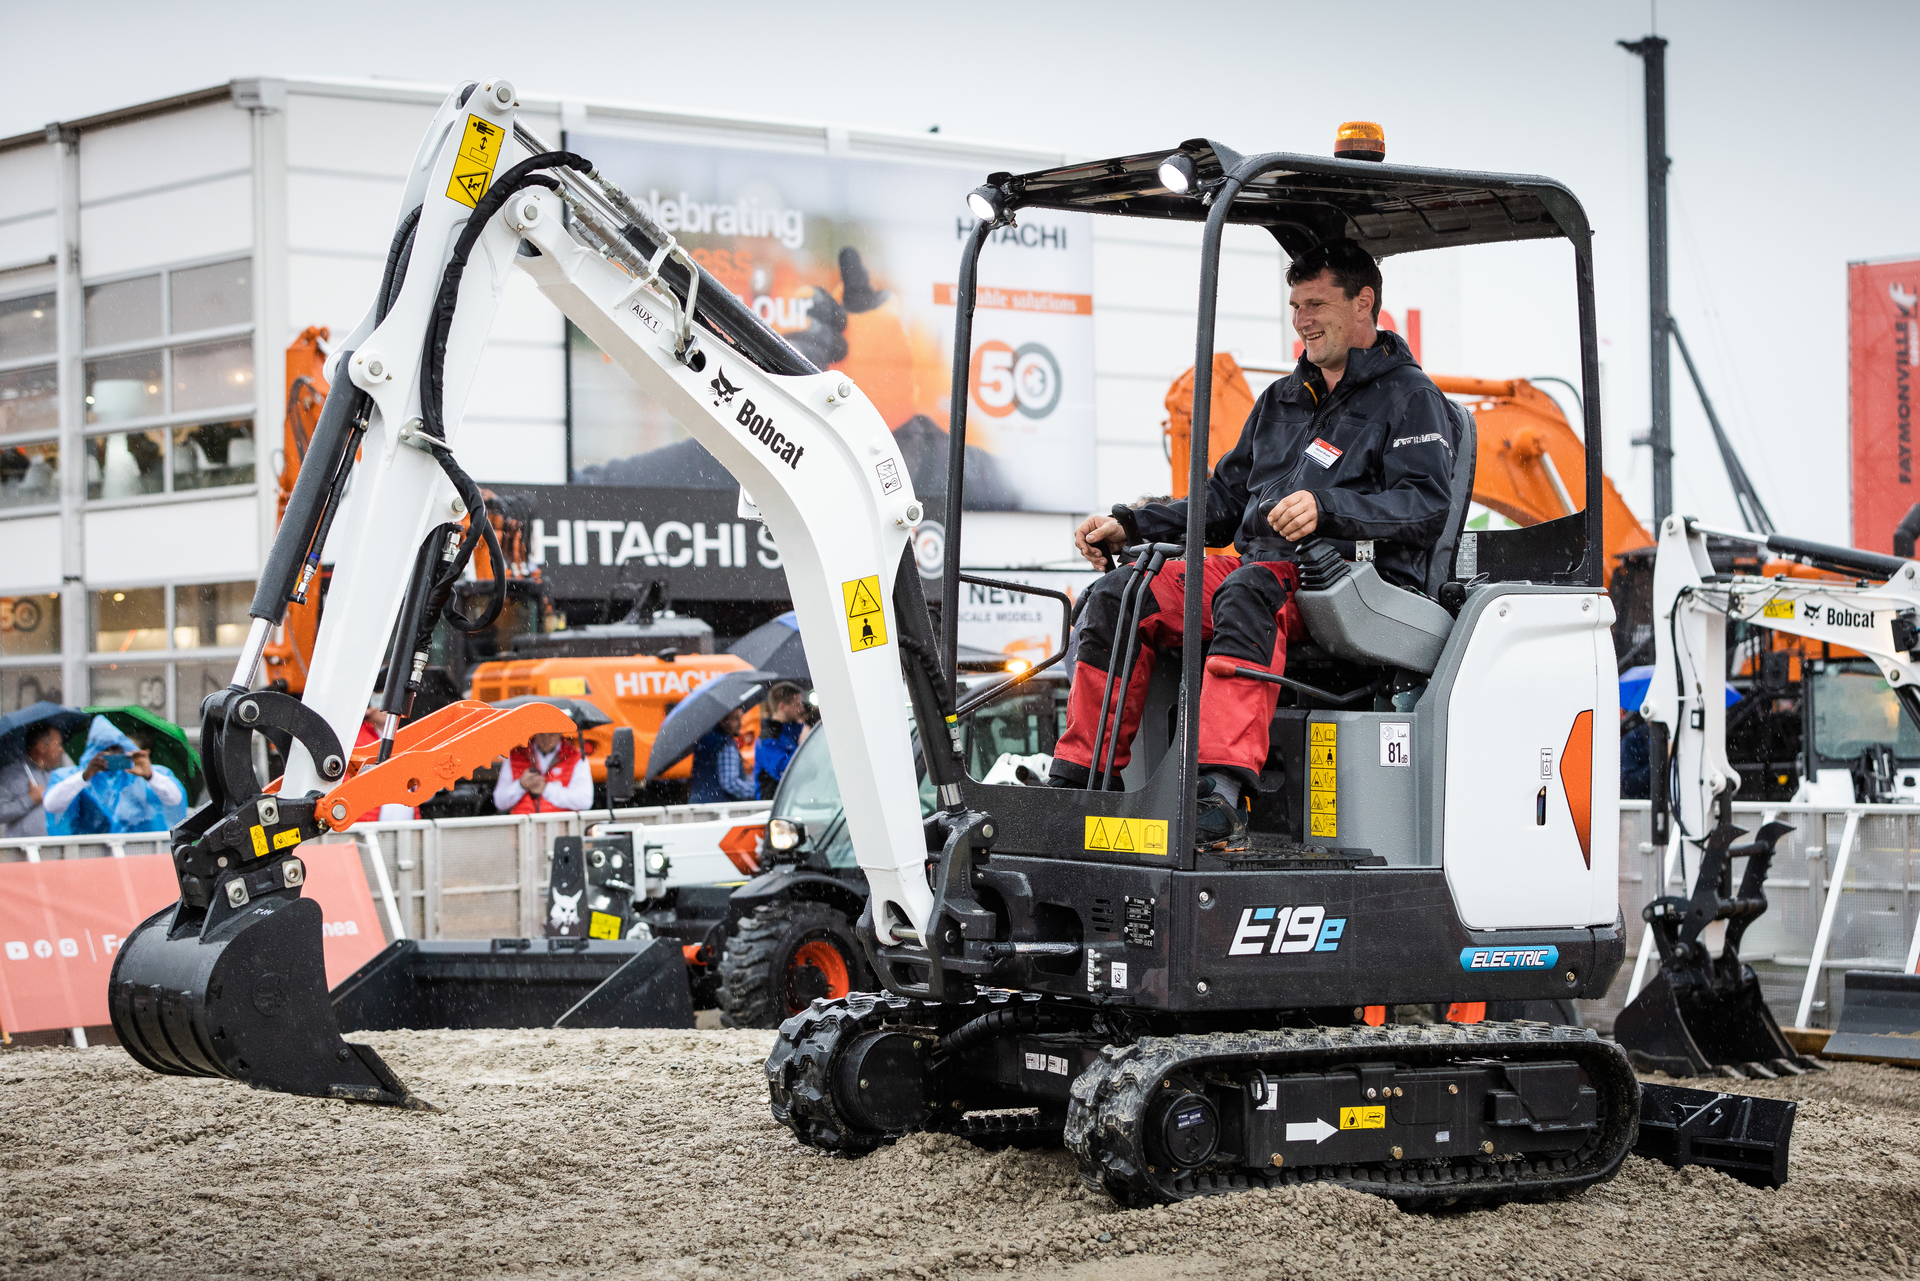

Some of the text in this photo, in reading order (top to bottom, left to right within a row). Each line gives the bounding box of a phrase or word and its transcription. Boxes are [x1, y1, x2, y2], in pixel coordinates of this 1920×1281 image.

[956, 217, 1068, 250] HTACHI
[631, 304, 653, 325] AUX
[652, 320, 659, 329] 1
[1011, 292, 1078, 313] solutions
[1895, 320, 1913, 485] FAYMONVILLE
[735, 398, 805, 471] Bobcat
[531, 518, 748, 569] HITACHI
[1827, 607, 1875, 628] Bobcat
[1388, 742, 1401, 763] 81
[1228, 906, 1347, 955] E19e
[1470, 949, 1549, 968] ELECTRIC
